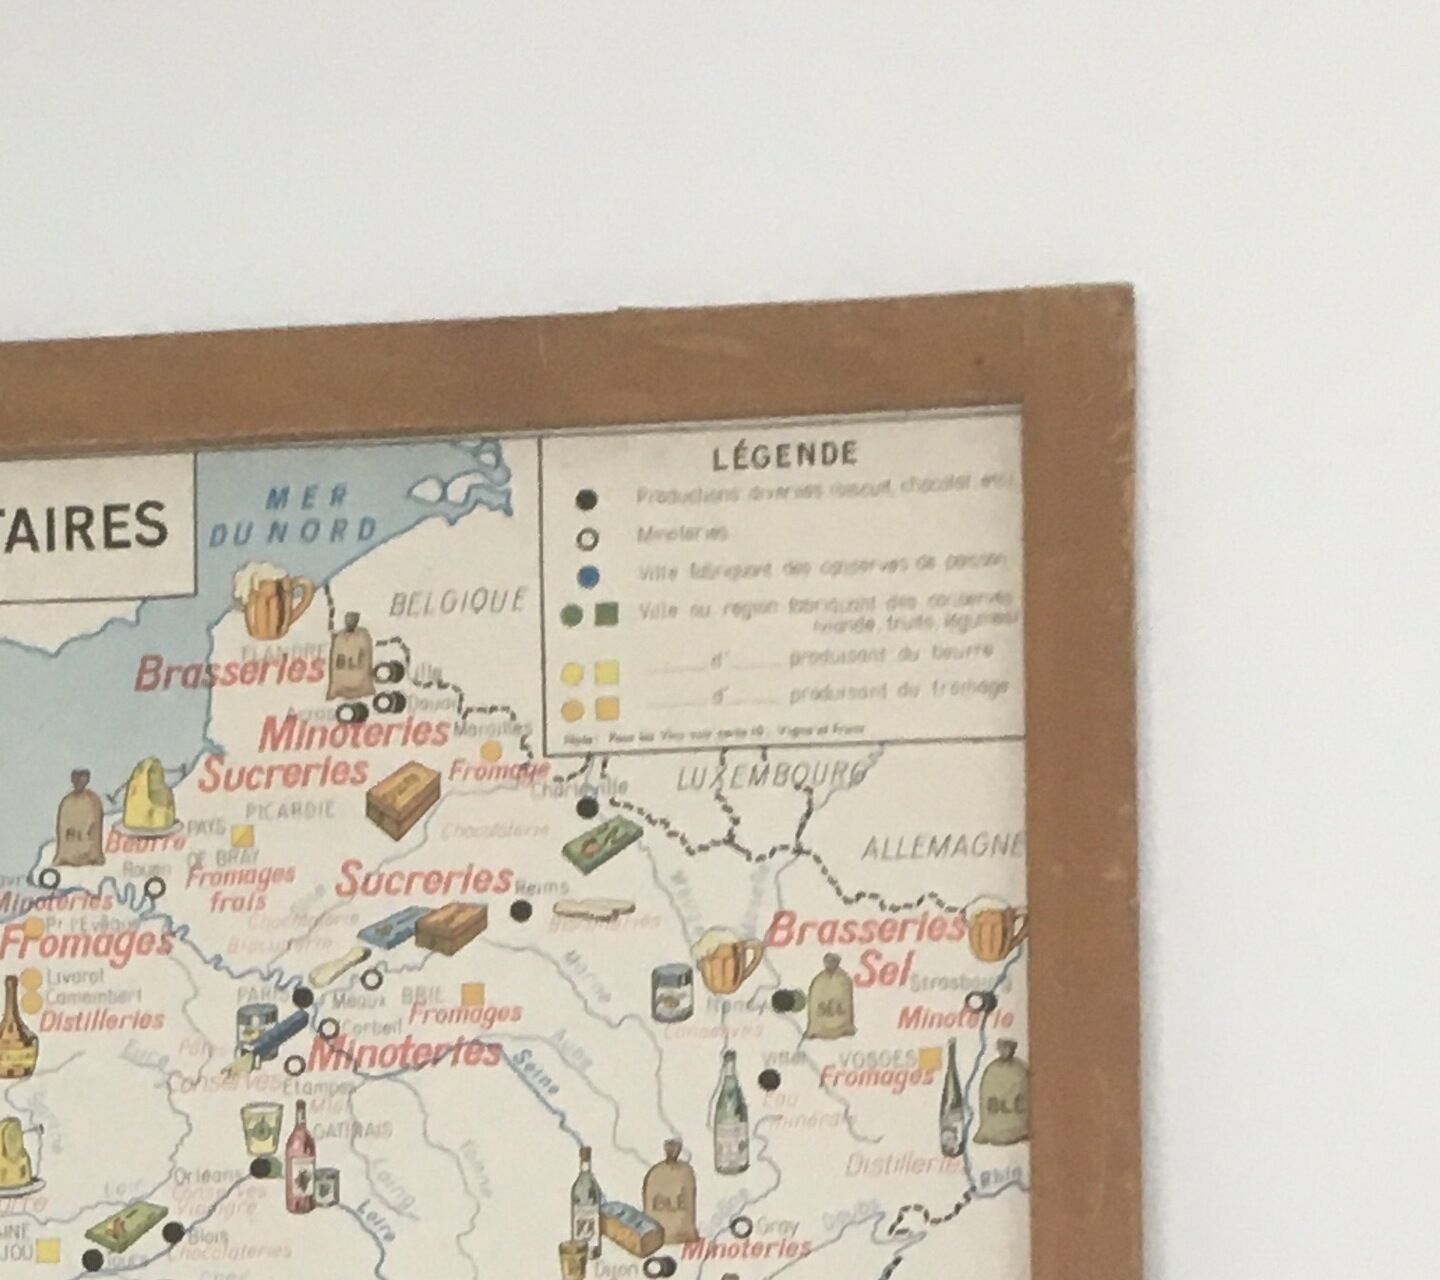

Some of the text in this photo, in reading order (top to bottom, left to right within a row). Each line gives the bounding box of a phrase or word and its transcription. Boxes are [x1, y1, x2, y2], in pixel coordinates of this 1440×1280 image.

[713, 439, 858, 471] LÉGENDE
[266, 483, 348, 510] MER
[209, 517, 377, 547] DU NORD
[639, 565, 678, 581] Ville
[389, 587, 528, 617] BELGIQUE
[639, 603, 678, 620] Ville
[134, 654, 326, 691] Brasseries
[259, 715, 450, 752] Minoteries
[198, 756, 370, 792] Sucreries
[449, 759, 552, 784] Fromage
[677, 760, 874, 791] LUXEMBOURG
[245, 801, 336, 818] PICARDIE
[862, 832, 1024, 861] ALLEMAGNE
[186, 866, 296, 892] Fromages
[336, 859, 514, 896] Sucreries
[210, 892, 267, 913] frais
[765, 910, 967, 947] Brasseries
[854, 949, 916, 988] Sel
[39, 1008, 165, 1033] Distilleries
[409, 1002, 523, 1028] Fromages
[898, 1005, 1014, 1030] Minoteie
[308, 1036, 503, 1071] Minoteries
[819, 1066, 935, 1094] Fromages
[681, 1236, 811, 1261] Minoteries
